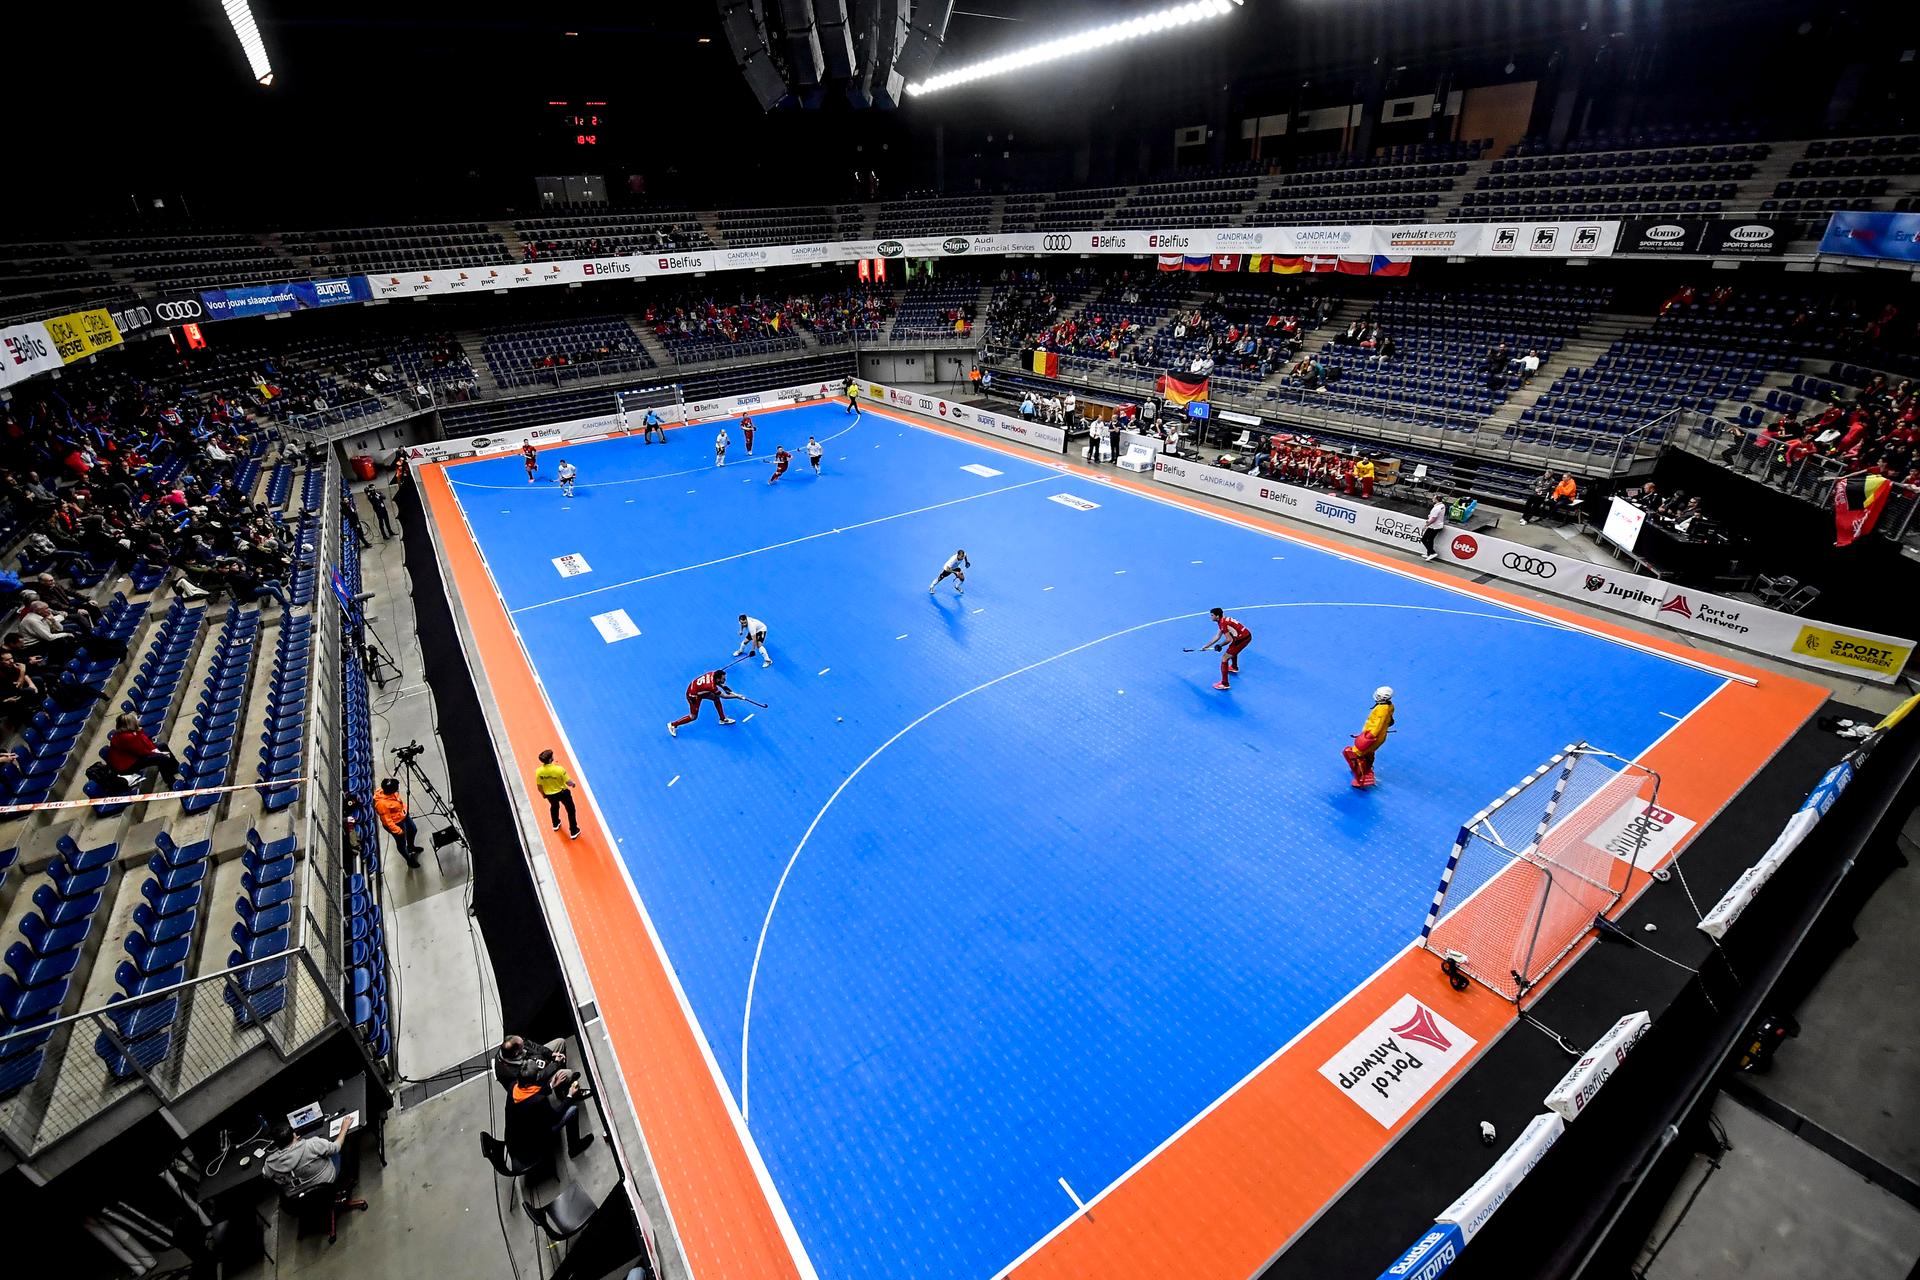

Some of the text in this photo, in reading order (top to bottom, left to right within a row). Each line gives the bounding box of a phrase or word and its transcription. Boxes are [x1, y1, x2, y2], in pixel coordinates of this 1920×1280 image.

[1216, 232, 1254, 240] CANDRIAM
[1296, 232, 1340, 240] CANDRIAM
[1391, 230, 1457, 238] verhulst events
[1649, 228, 1681, 238] domo
[1734, 228, 1770, 238] domo
[974, 236, 994, 244] Audi
[1100, 236, 1126, 248] Belfius
[1159, 234, 1188, 248] Belfius
[792, 246, 820, 254] CANDRIAM
[878, 244, 903, 255] Sligro
[944, 241, 968, 252] Sligro
[974, 244, 1010, 252] Financial
[728, 250, 759, 259] CANDRIAM
[596, 262, 630, 274] Belfius
[670, 256, 702, 268] Belfius
[480, 278, 495, 286] pwc
[516, 276, 530, 284] pwc
[316, 281, 350, 296] auping
[381, 286, 397, 294] pwc
[414, 284, 429, 292] pwc
[206, 293, 295, 310] Voor jouw slaapcomfort
[738, 395, 760, 406] auping
[700, 403, 719, 412] Belfius
[1194, 407, 1203, 416] 40
[582, 420, 612, 429] CANDRIAM
[977, 414, 996, 428] auping
[538, 428, 560, 438] Belfius
[1002, 422, 1028, 436] EuroHockey
[1164, 464, 1186, 478] Belfius
[1200, 474, 1236, 488] CANDRIAM
[1269, 490, 1297, 507] Belfius
[1315, 500, 1358, 524] auping
[1375, 526, 1422, 544] MEN EXPER
[1454, 540, 1475, 553] lotto
[1604, 582, 1663, 606] Jupiler
[1700, 604, 1740, 622] Port of
[1696, 614, 1749, 634] Antwerp
[1830, 648, 1891, 668] VLAANDEREN
[1338, 1037, 1402, 1089] Antwerp
[1371, 1052, 1424, 1098] Port of
[1583, 1067, 1611, 1101] Belfius
[1467, 1192, 1506, 1234] CANDRIAM
[1389, 1232, 1445, 1274] auping
